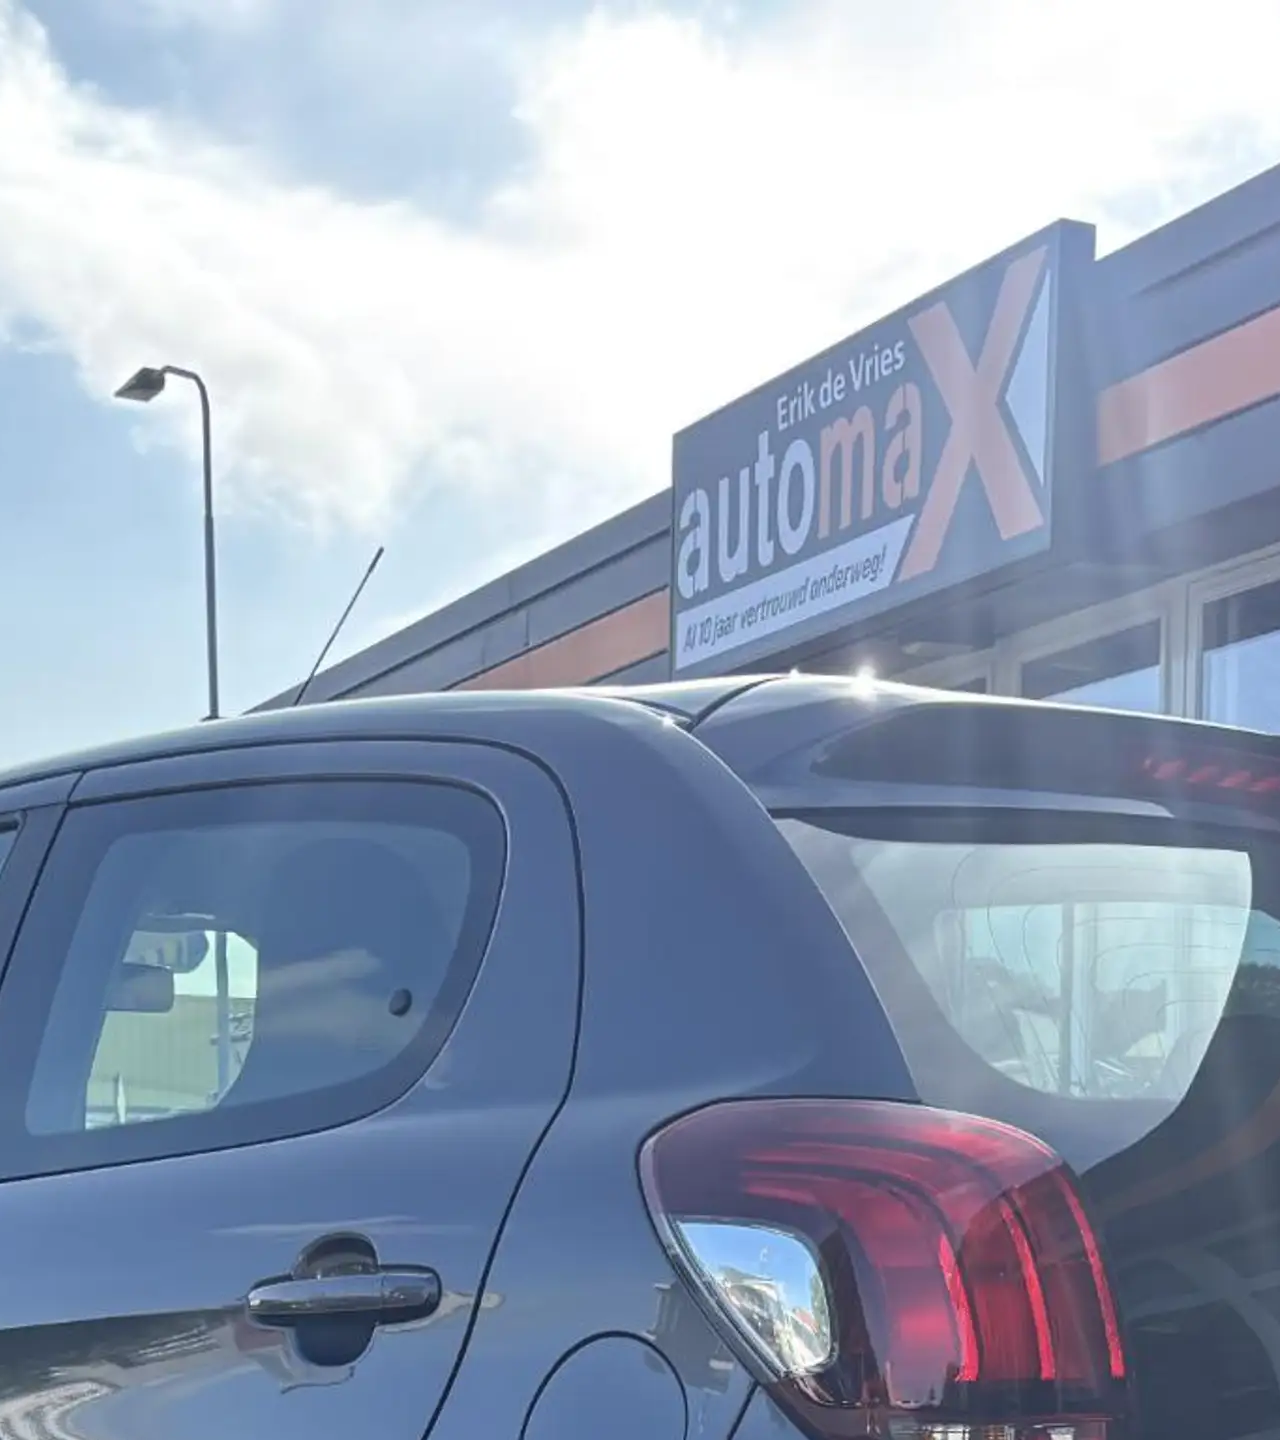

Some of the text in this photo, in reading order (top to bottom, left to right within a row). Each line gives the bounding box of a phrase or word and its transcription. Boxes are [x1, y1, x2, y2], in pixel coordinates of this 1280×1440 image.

[777, 340, 906, 432] Erik de Vries
[699, 614, 712, 644] 10
[712, 610, 738, 646] jaar
[740, 577, 811, 629] vertrouwd
[811, 544, 886, 599] onderweg!
